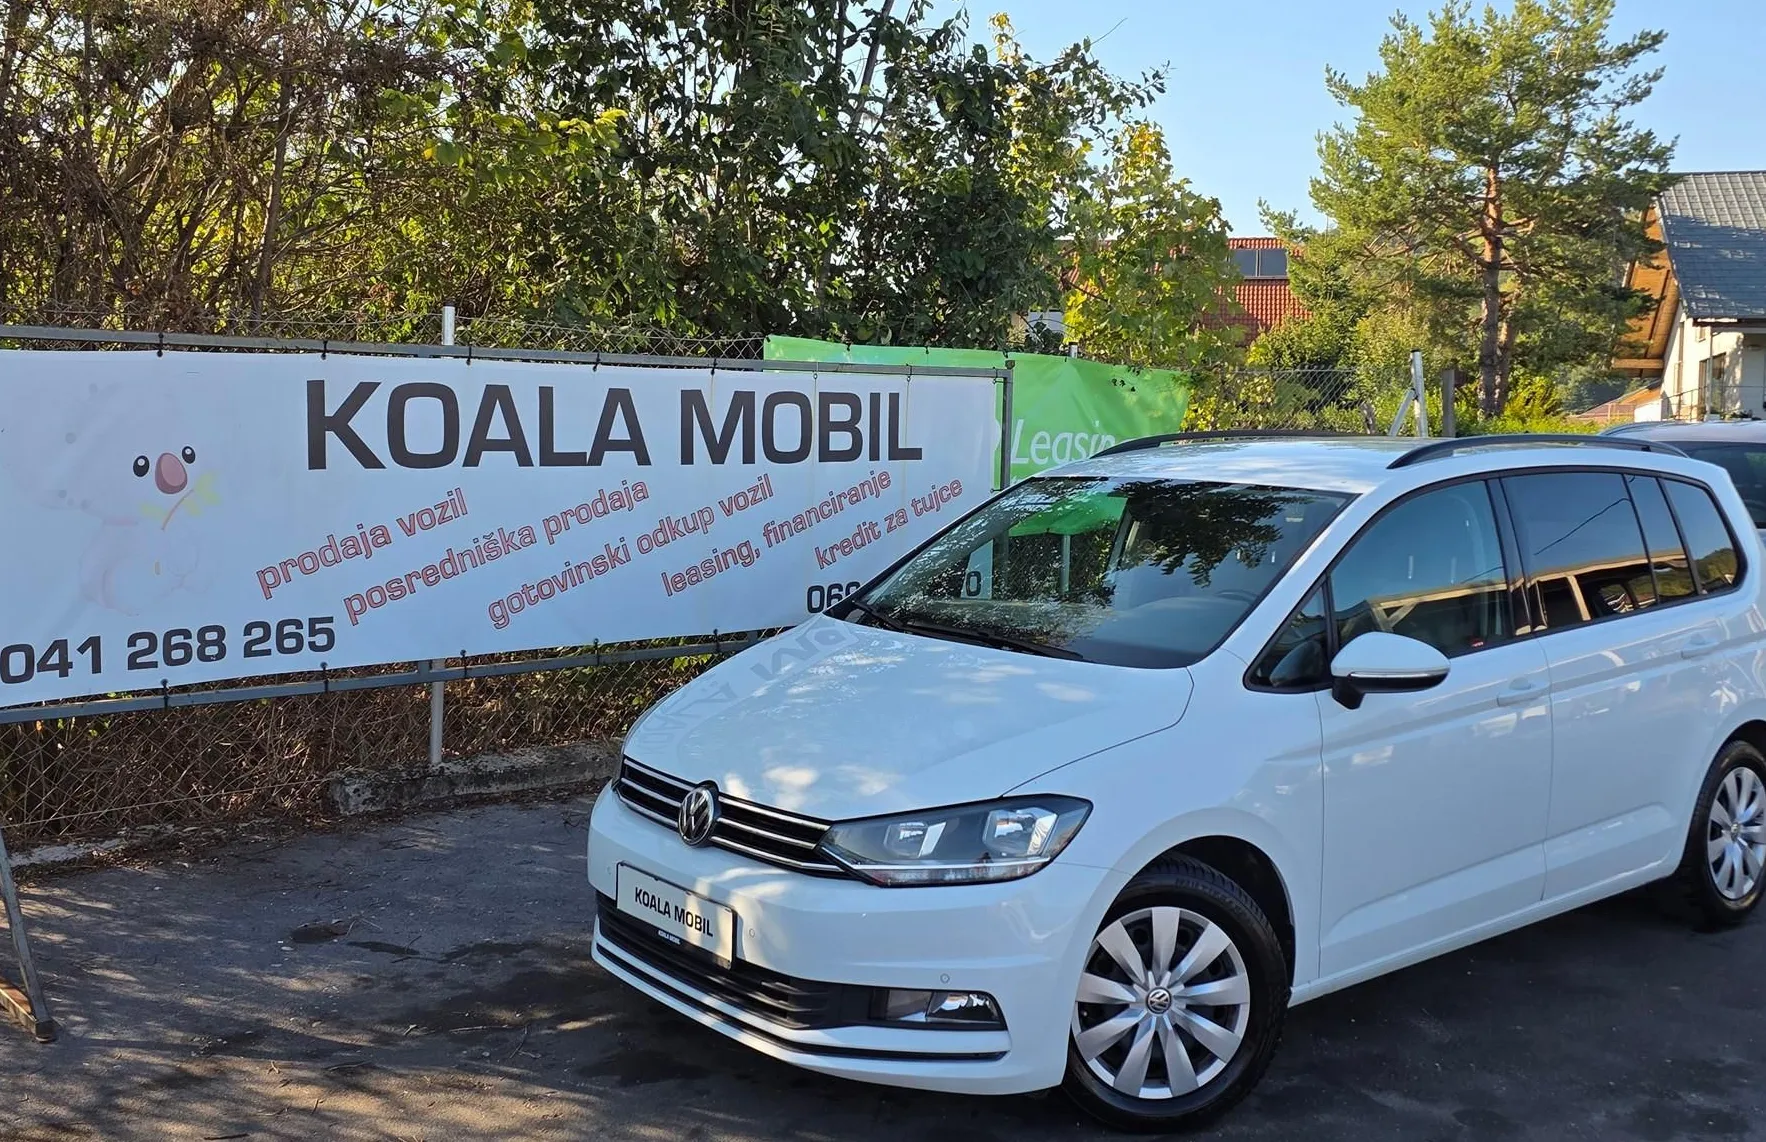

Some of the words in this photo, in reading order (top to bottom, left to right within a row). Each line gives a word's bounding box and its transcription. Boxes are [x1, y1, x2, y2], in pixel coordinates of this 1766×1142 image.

[306, 379, 652, 470] KOALA
[680, 388, 923, 466] MOBIL
[1011, 418, 1117, 465] Leasin
[255, 522, 392, 601] prodaja
[396, 487, 469, 538] vozil
[343, 525, 538, 627] posredniška
[541, 479, 650, 545] prodaja
[488, 536, 632, 630] gotovinski
[636, 506, 715, 555] odkup
[718, 473, 774, 518] vozil
[660, 539, 761, 597] leasing,
[762, 469, 892, 549] financiranje
[814, 520, 882, 570] kredit
[883, 507, 909, 535] za
[910, 478, 964, 517] tujce
[0, 635, 102, 685] 041
[127, 624, 227, 671] 268
[243, 616, 336, 659] 265
[635, 886, 671, 919] KOALA
[674, 905, 714, 938] MOBIL
